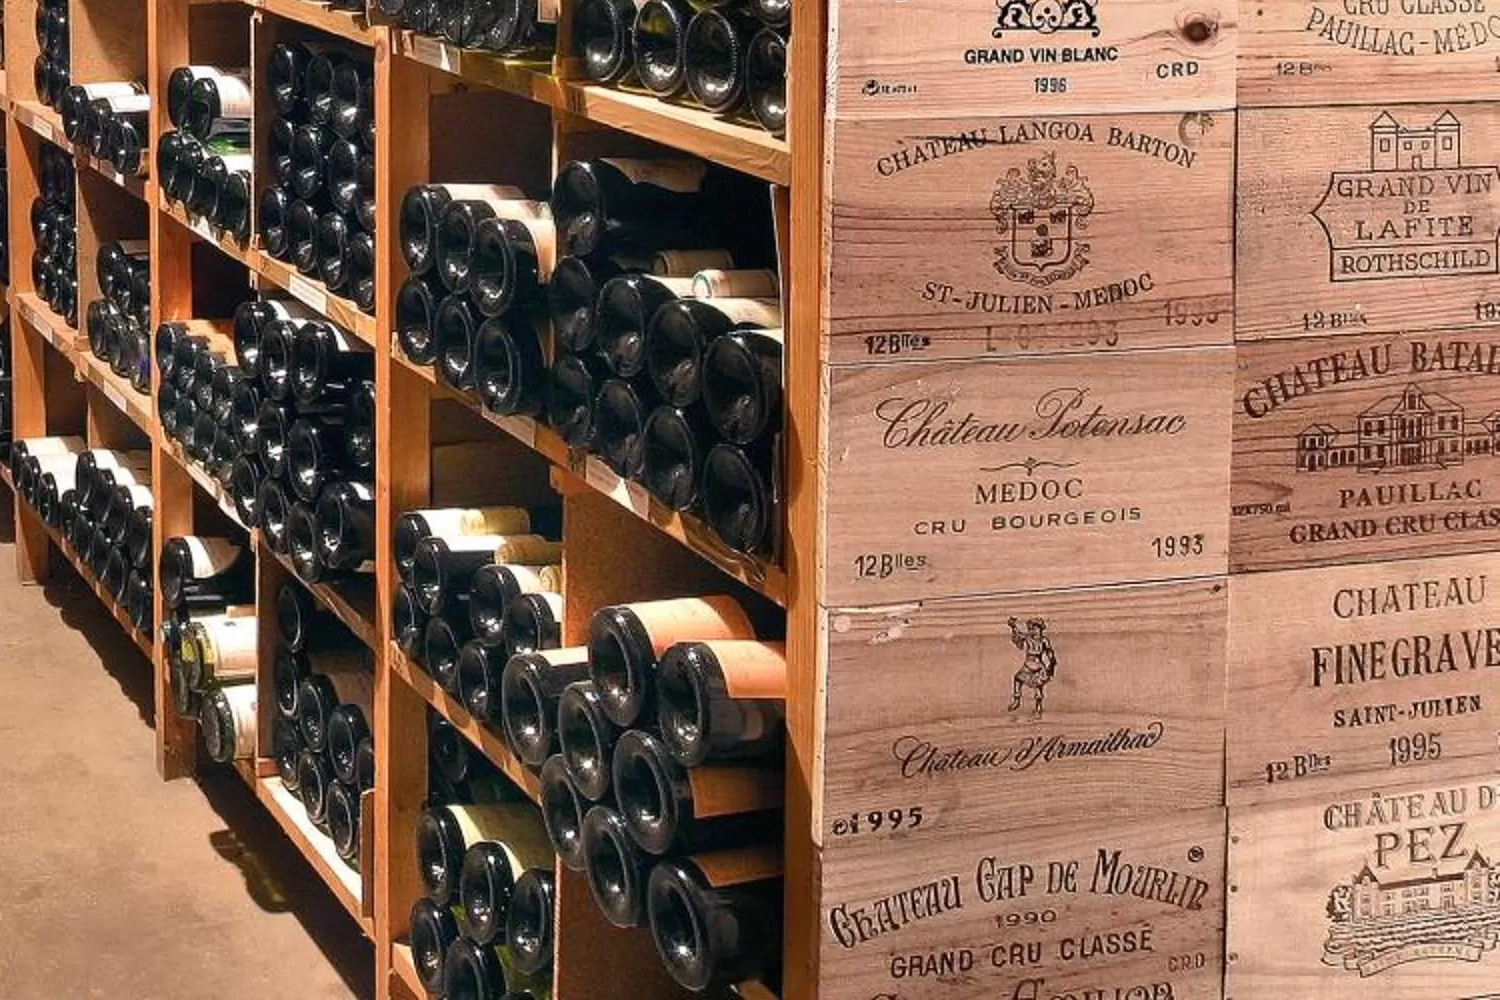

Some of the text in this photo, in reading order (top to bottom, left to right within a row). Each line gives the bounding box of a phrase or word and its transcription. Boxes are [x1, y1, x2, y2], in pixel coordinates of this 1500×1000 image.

[964, 47, 1118, 64] GRAND VIN BLANC
[1156, 61, 1200, 79] CRD
[877, 121, 1197, 177] CHATEAU LANGOA BARTON
[1337, 173, 1493, 199] GRAND VIN
[1403, 199, 1430, 214] DE
[1355, 215, 1474, 241] LAFITE
[1340, 248, 1491, 275] ROTHSCHILD
[1243, 344, 1393, 419] CHATEAU
[876, 387, 1187, 449] Château Potensac
[975, 478, 1085, 505] MEDOC
[1339, 479, 1482, 509] PAUILLAC
[914, 507, 1142, 536] CRU BOURGEOIS
[1289, 519, 1377, 544] GRAND
[1385, 514, 1435, 536] CRU
[1333, 575, 1487, 619] CHATEAU
[1333, 694, 1482, 728] SAINT-JULIEN
[892, 735, 1013, 779] Château
[1388, 732, 1442, 767] 1995
[1479, 785, 1500, 810] D
[1375, 822, 1469, 869] PEZ
[976, 856, 1034, 902] CAP
[1047, 861, 1079, 895] DE
[995, 909, 1057, 928] 1990
[891, 948, 974, 979] GRAND
[990, 941, 1042, 968] CRU
